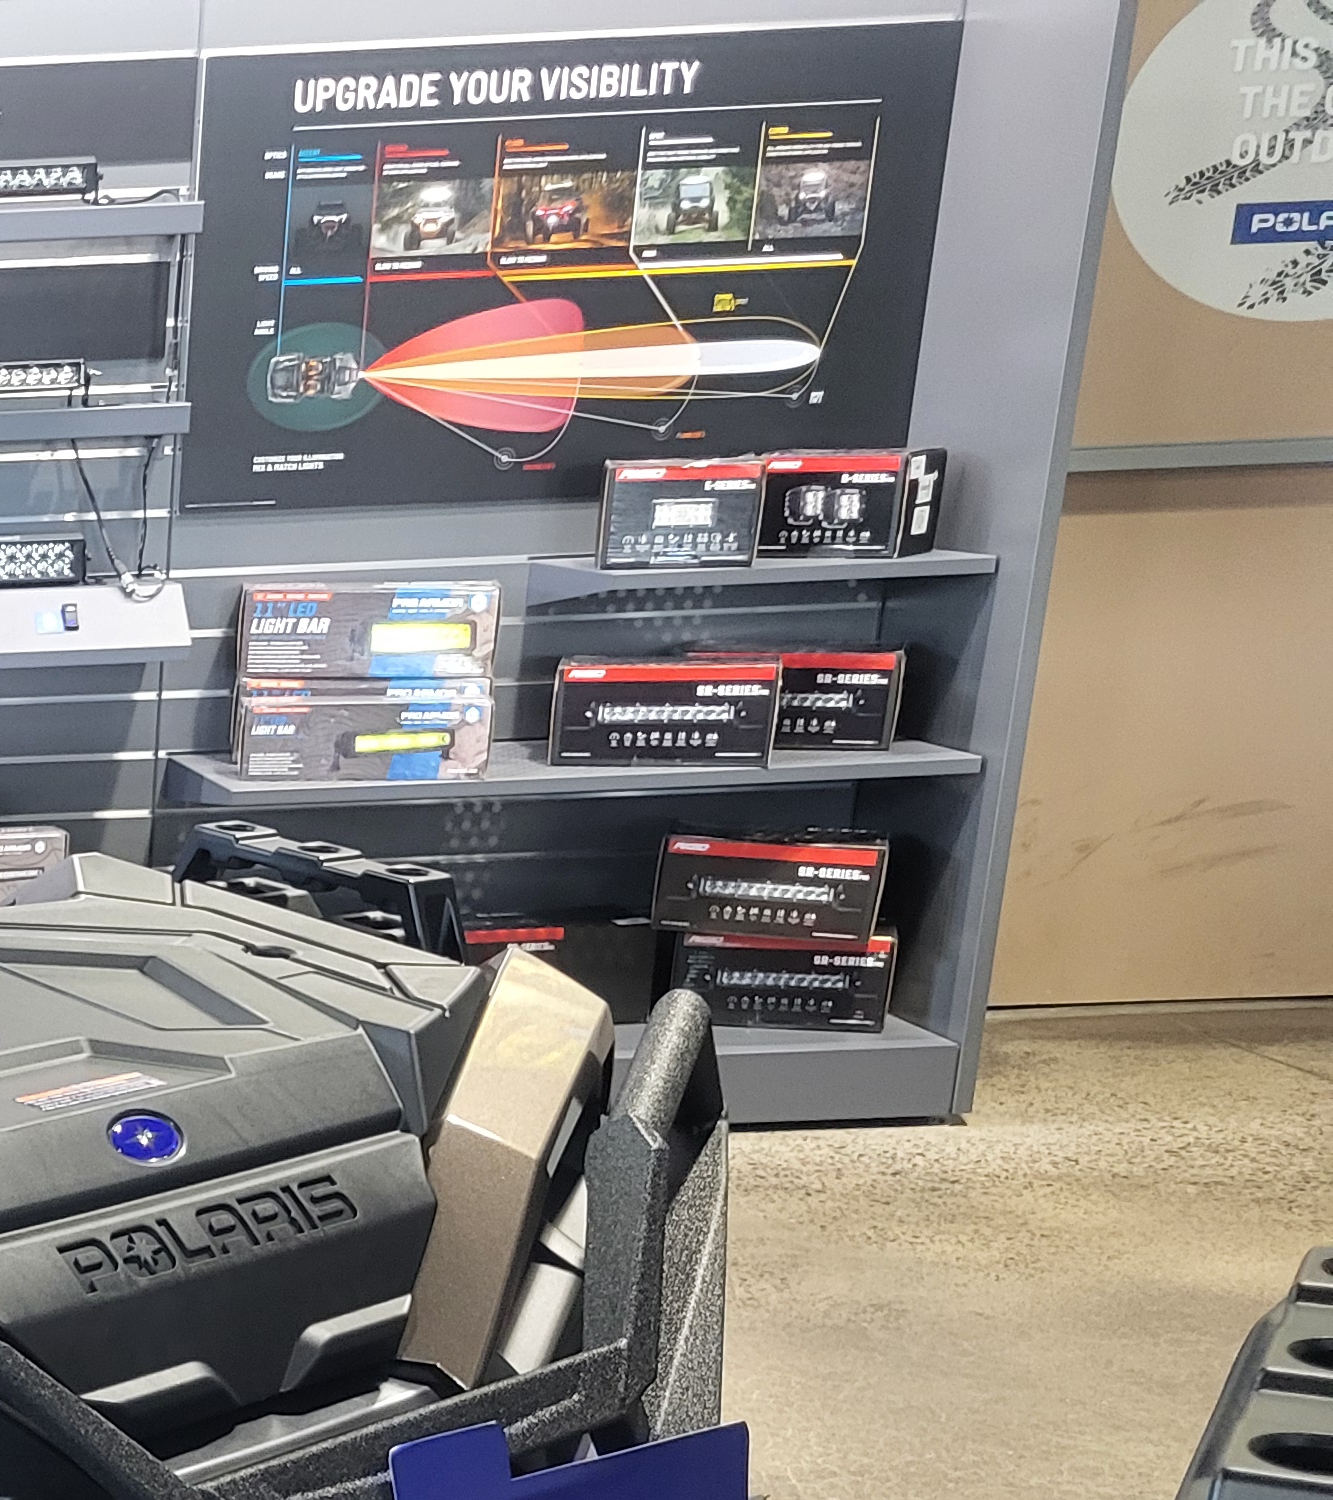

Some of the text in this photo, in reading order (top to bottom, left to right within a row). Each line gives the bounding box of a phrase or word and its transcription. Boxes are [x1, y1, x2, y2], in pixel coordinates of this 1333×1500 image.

[1230, 36, 1319, 73] THIS
[293, 60, 701, 114] UPGRADE YOUR VISIBILITY
[1238, 83, 1317, 120] THE
[1232, 130, 1333, 167] OUTD
[250, 617, 331, 634] LIGHT BAR
[288, 602, 318, 617] LED
[251, 725, 276, 736] LIGHT
[3, 844, 31, 853] ARMOR
[56, 1174, 359, 1294] POLARIS
